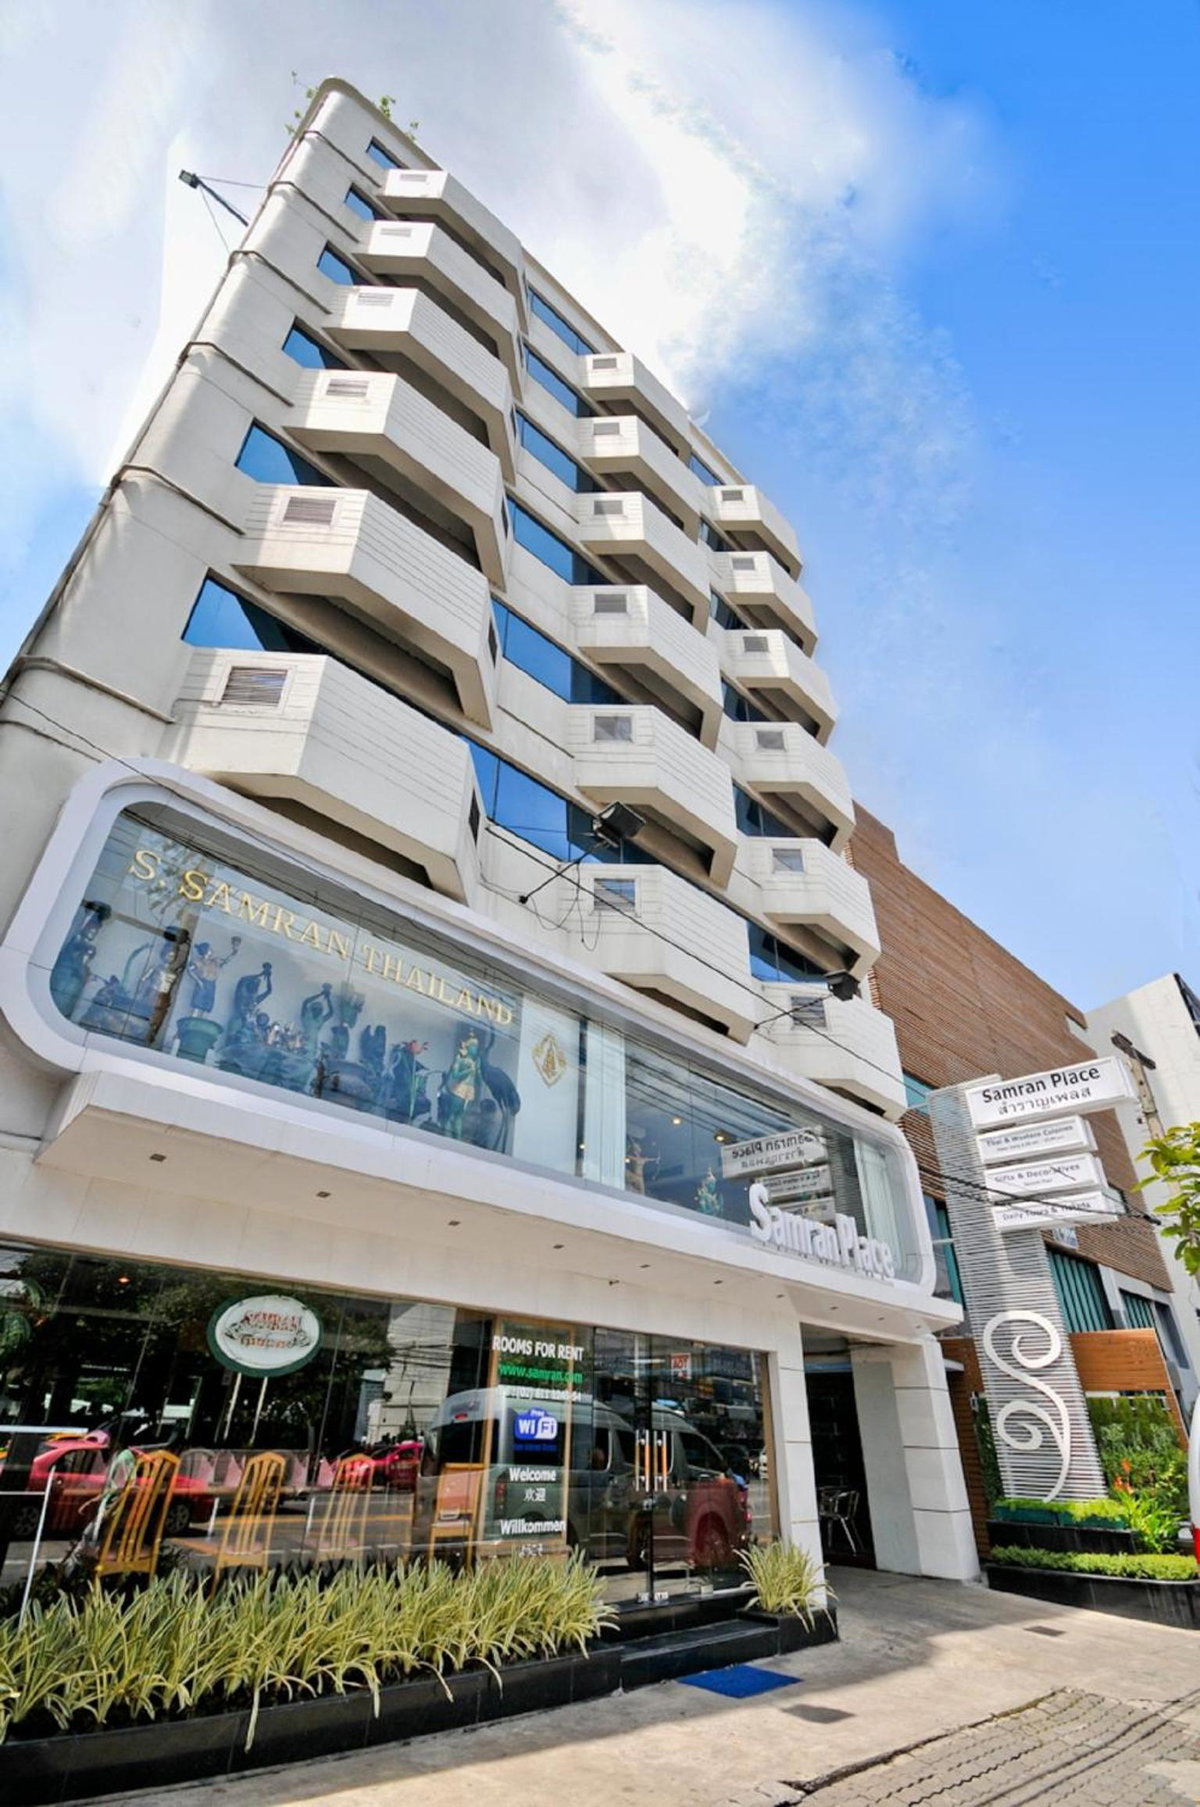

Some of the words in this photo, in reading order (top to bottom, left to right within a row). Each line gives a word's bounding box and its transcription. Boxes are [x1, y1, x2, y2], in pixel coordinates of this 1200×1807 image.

[129, 849, 166, 888] S.
[178, 870, 351, 960] SAMRAN
[360, 944, 513, 1025] THAILAND
[982, 1079, 1047, 1103] Samran
[1050, 1068, 1101, 1088] Place
[749, 1183, 840, 1263] Samran
[835, 1213, 895, 1278] Place
[492, 1335, 533, 1355] ROOMS
[534, 1341, 556, 1358] FOR
[557, 1344, 584, 1361] RENT
[499, 1364, 583, 1384] www.samran.com
[509, 1467, 556, 1482] Welcome
[500, 1519, 567, 1534] Willkommen
